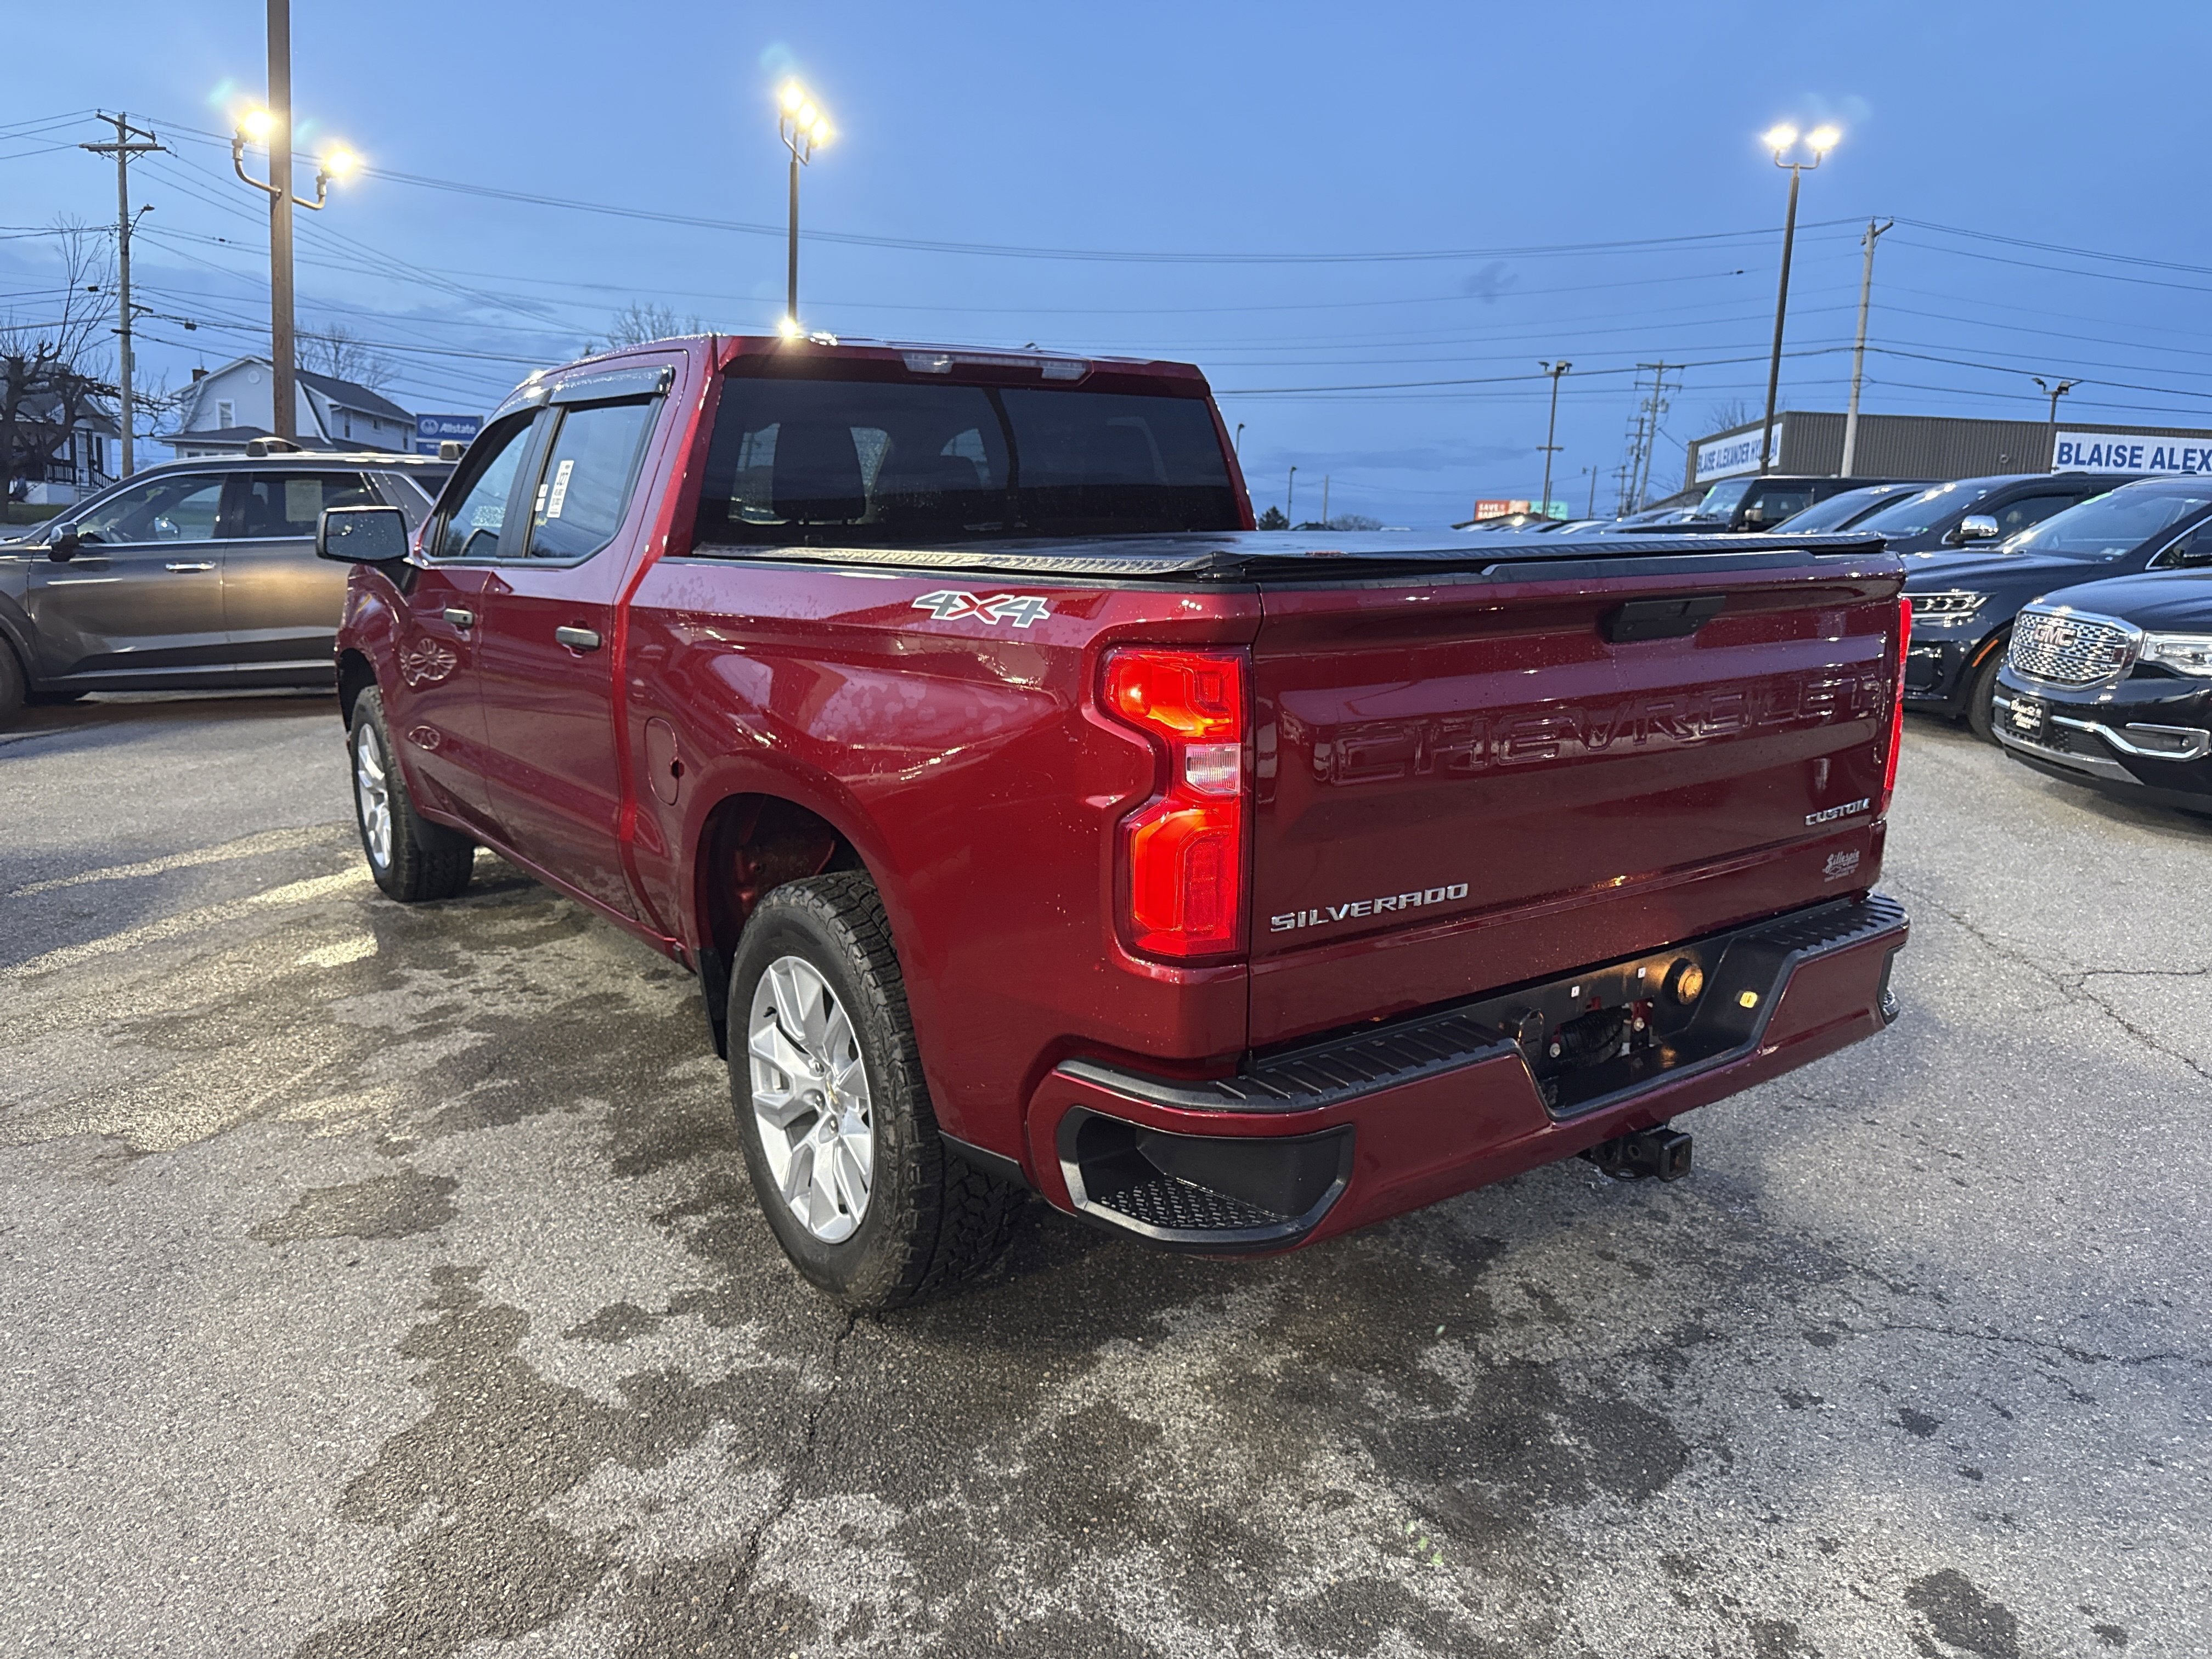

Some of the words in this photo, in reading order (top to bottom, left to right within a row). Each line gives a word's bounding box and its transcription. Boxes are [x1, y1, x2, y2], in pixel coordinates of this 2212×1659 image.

[439, 422, 476, 435] Allstate
[2057, 442, 2144, 468] BLAISE
[1478, 503, 1498, 512] SAVE
[2033, 624, 2076, 647] GMC
[1330, 666, 1882, 787] CHEVROLET
[1805, 798, 1871, 826] CUSTOM
[1271, 883, 1469, 933] SILVERADO
